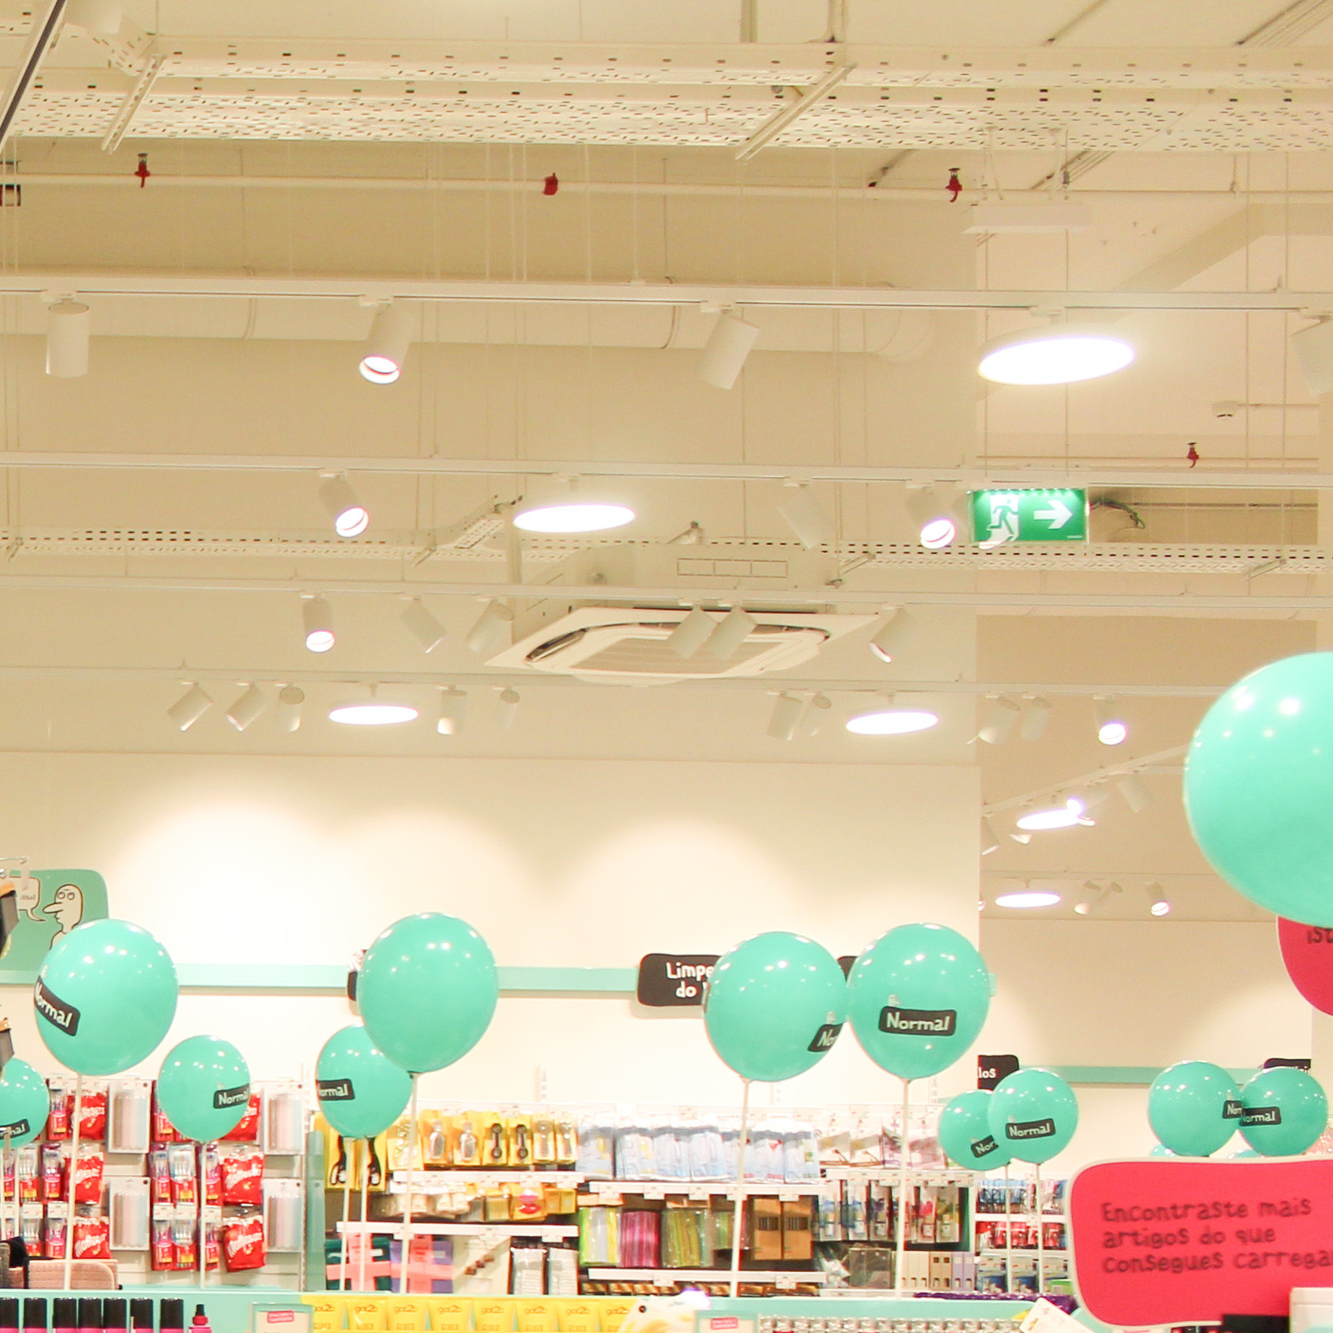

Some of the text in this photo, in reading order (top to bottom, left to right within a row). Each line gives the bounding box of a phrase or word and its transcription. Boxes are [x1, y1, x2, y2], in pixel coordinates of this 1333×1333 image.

[666, 961, 713, 981] Limpe
[676, 983, 697, 999] do
[886, 1012, 951, 1032] Normal
[319, 1082, 348, 1098] ormal
[1009, 1122, 1051, 1138] Normal
[1101, 1198, 1312, 1222] Encontraste mais
[1103, 1225, 1277, 1249] artigos do que
[1102, 1252, 1224, 1274] consegues
